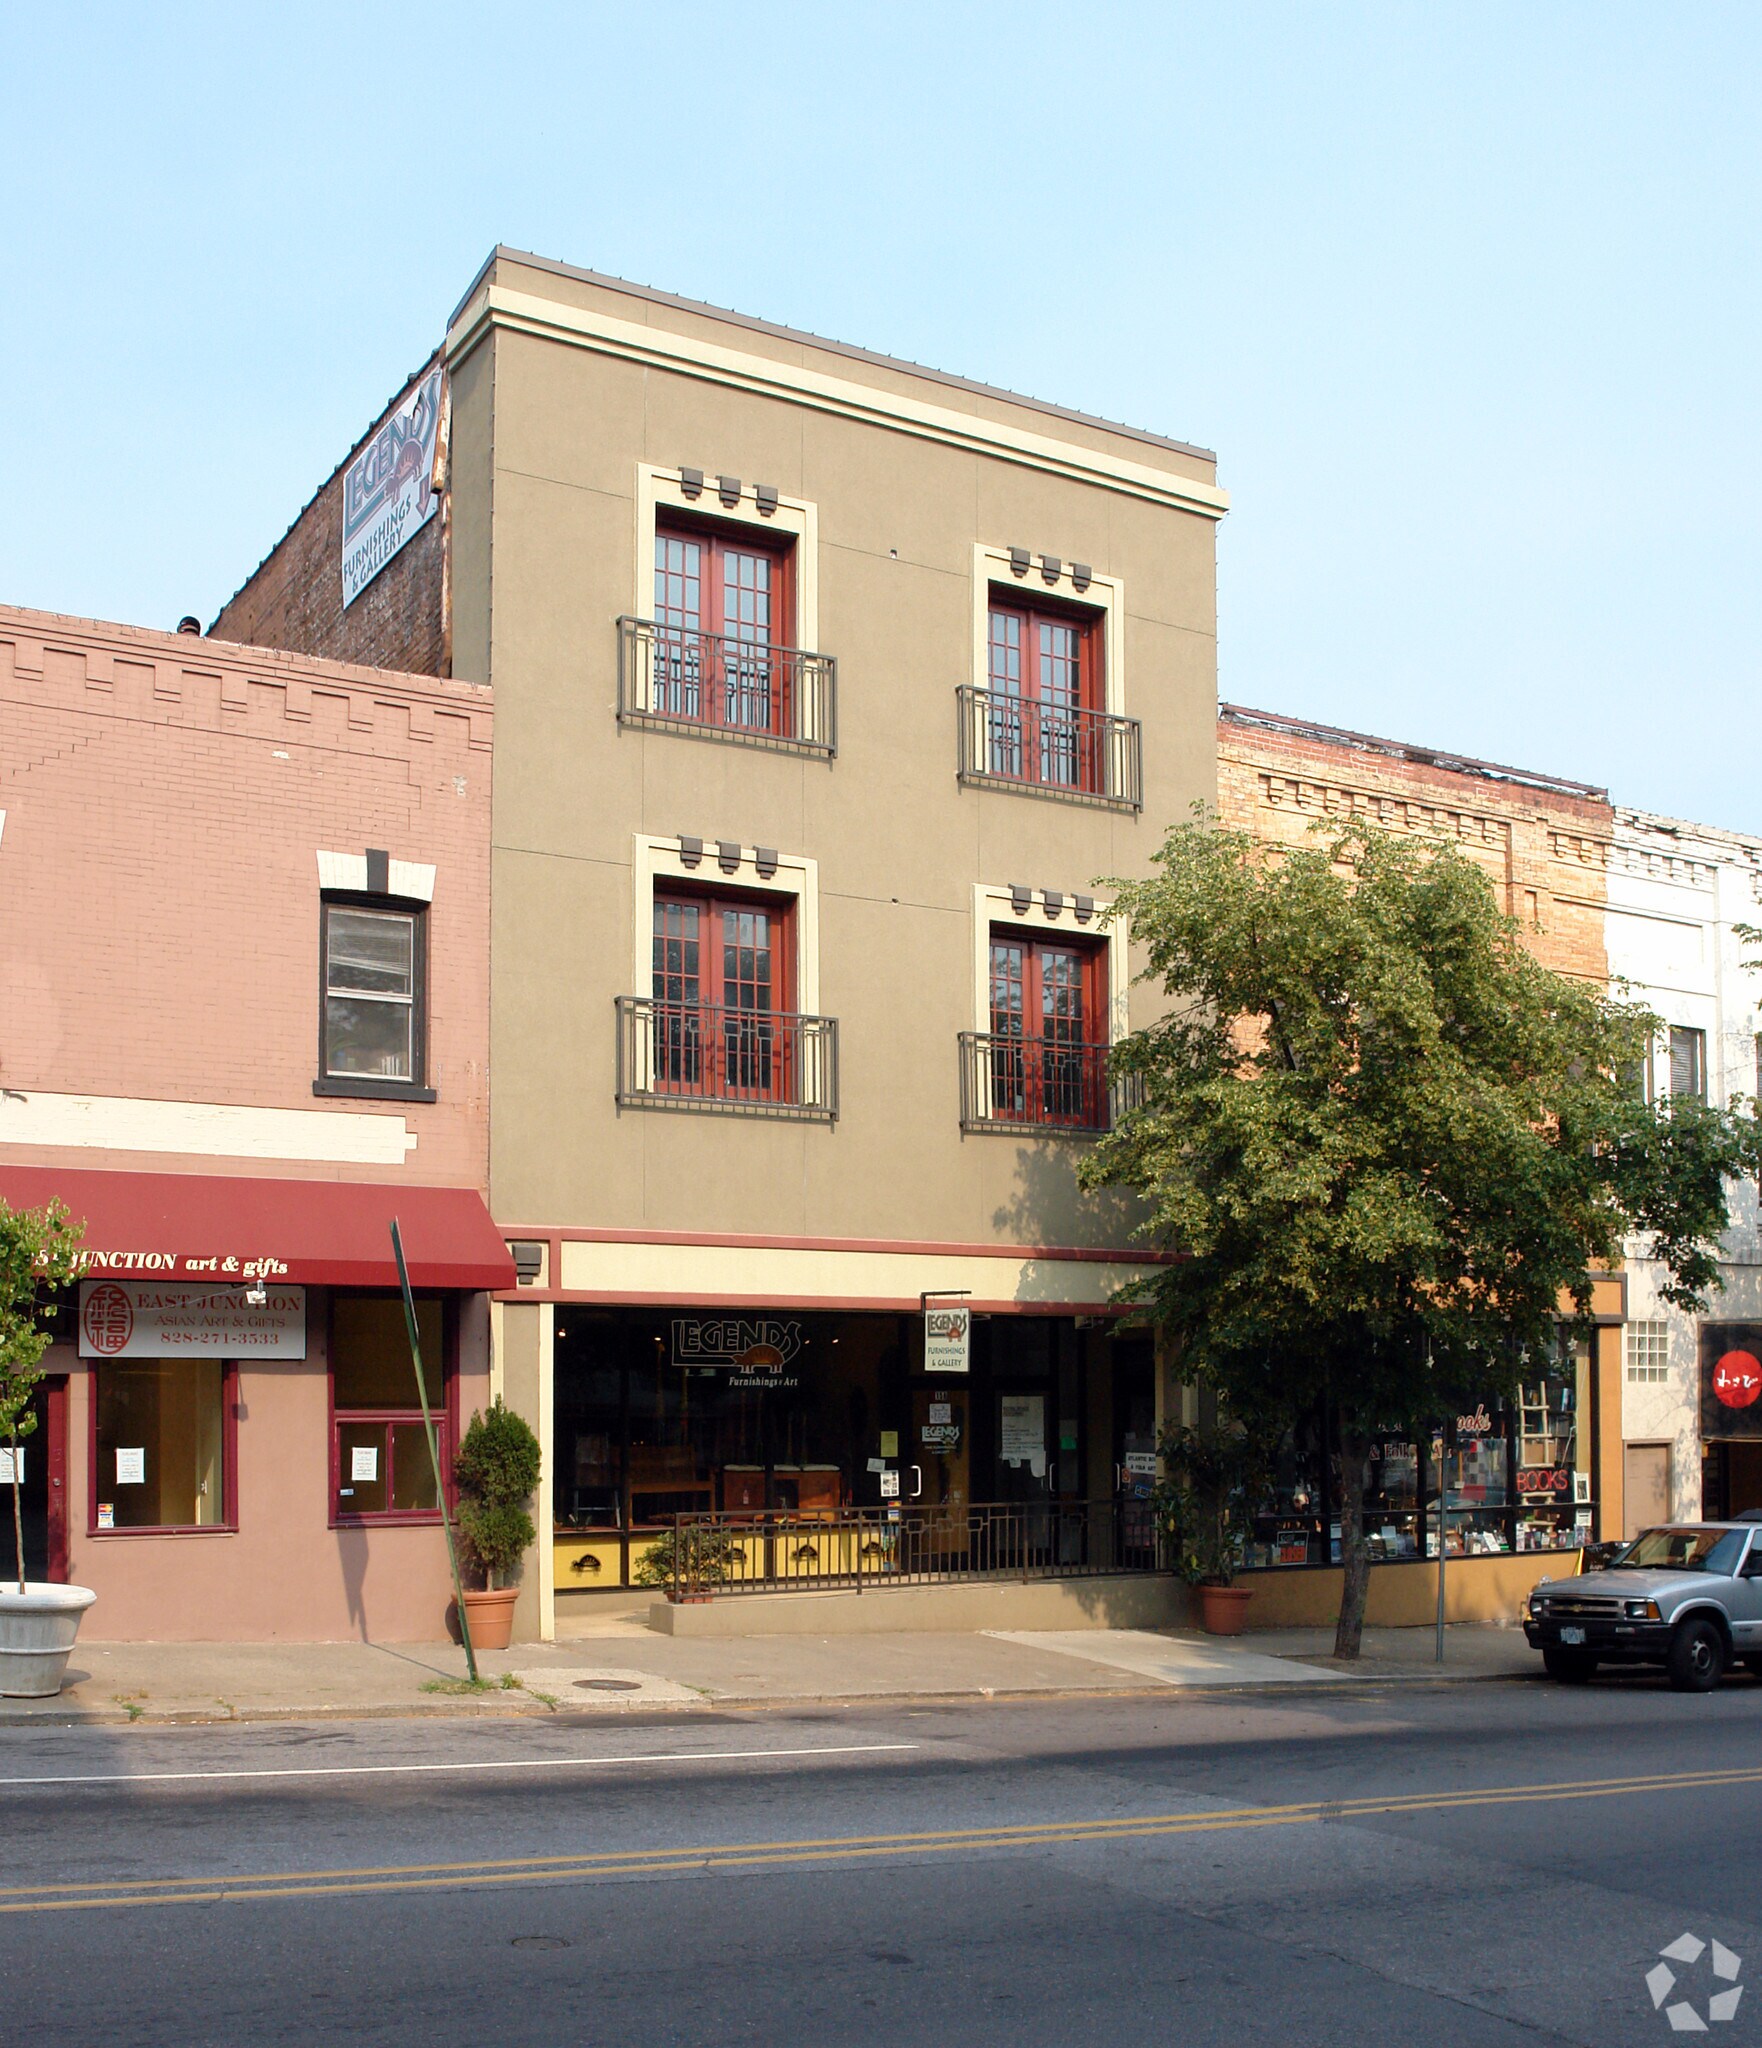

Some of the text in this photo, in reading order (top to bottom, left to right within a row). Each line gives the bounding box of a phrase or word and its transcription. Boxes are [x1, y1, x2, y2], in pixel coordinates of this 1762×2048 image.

[343, 494, 412, 584] FURNISHINGS
[351, 523, 404, 594] & GALLERY
[185, 1257, 218, 1271] art
[221, 1256, 240, 1272] &
[242, 1257, 289, 1278] gifts
[137, 1294, 191, 1309] EAST
[232, 1315, 244, 1328] &
[927, 1313, 968, 1339] LEGENDS
[160, 1332, 279, 1346] 828-271-3533
[672, 1320, 801, 1367] LEGENDS
[927, 1346, 966, 1355] FURNISHINGS
[937, 1359, 962, 1367] GALLERY
[729, 1376, 778, 1388] Furnishings
[784, 1377, 798, 1386] Art
[1456, 1403, 1492, 1432] ooks
[921, 1426, 960, 1443] LEGENDS
[1516, 1469, 1569, 1492] BOOKS
